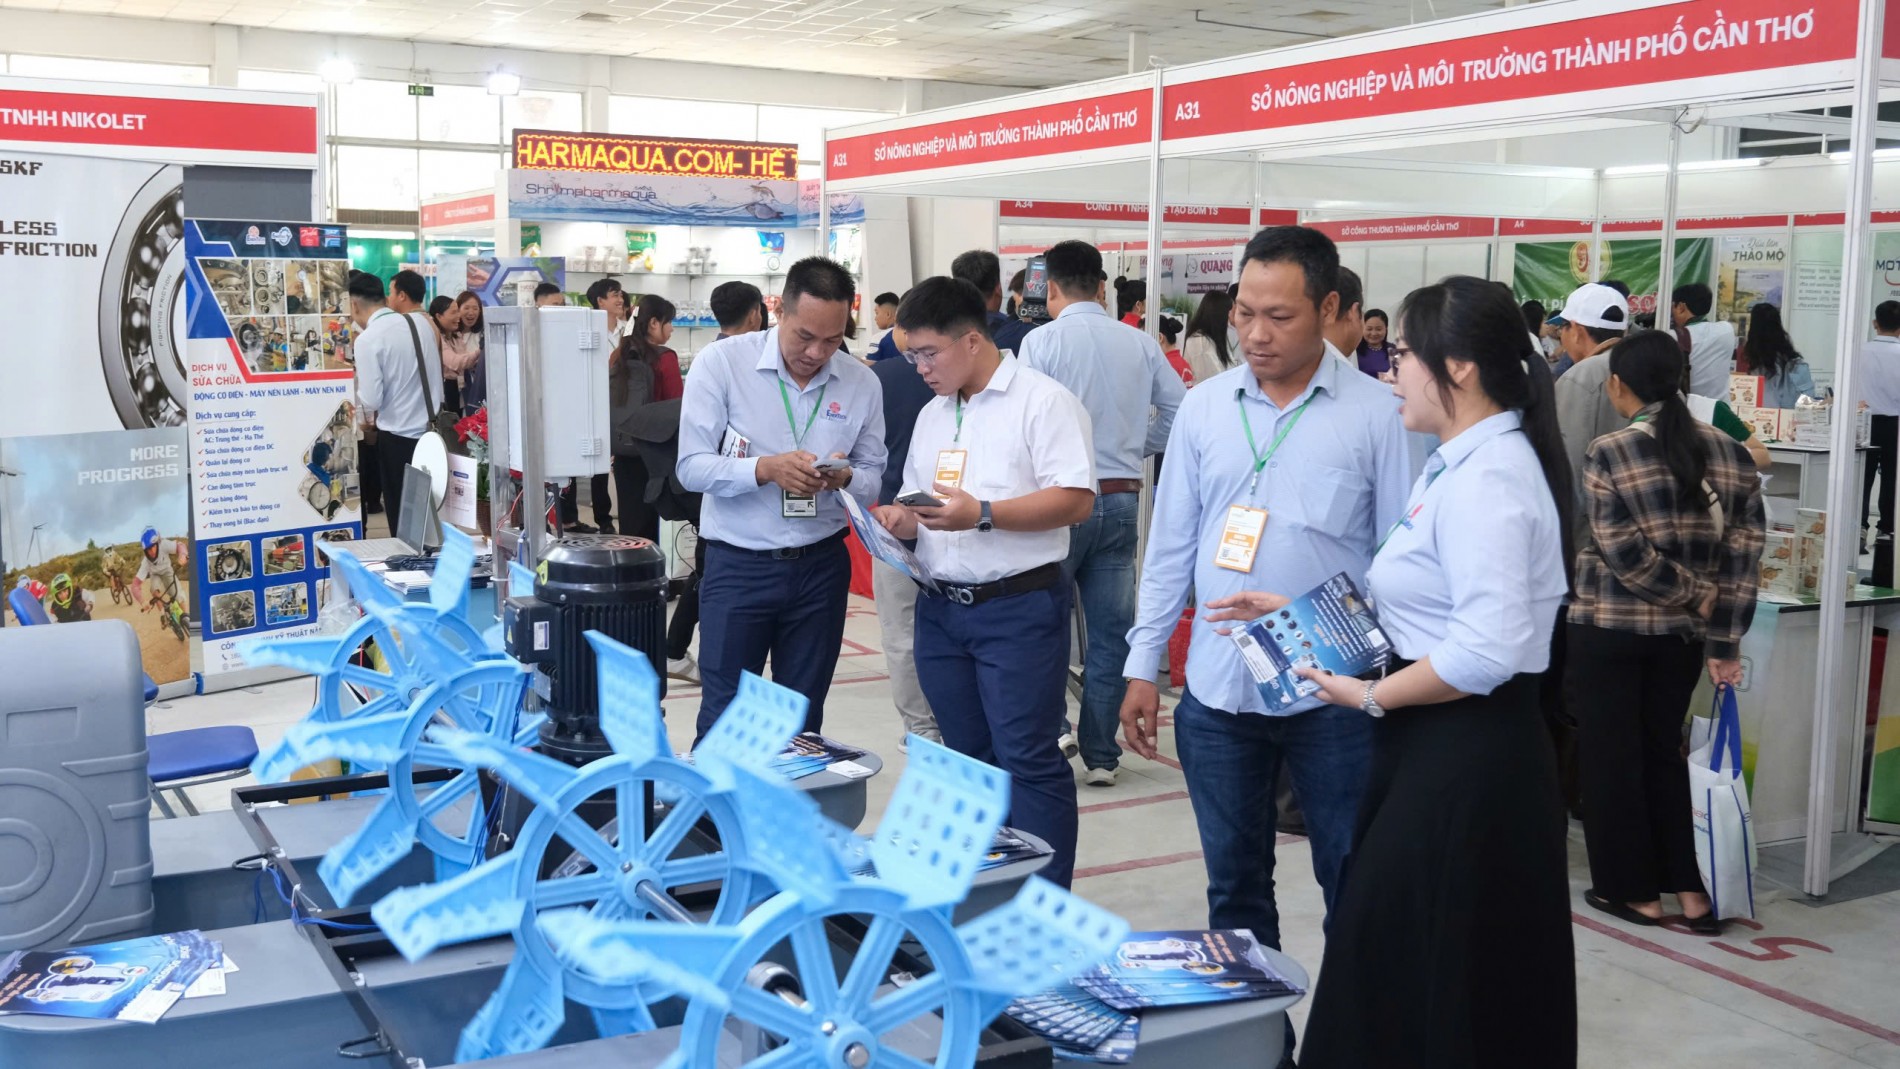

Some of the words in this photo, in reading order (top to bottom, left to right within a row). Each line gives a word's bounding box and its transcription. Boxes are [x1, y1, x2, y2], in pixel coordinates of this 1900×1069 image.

[1175, 101, 1200, 121] A31
[1251, 84, 1272, 112] SỞ
[1275, 81, 1321, 109] NÔNG
[1324, 70, 1387, 101] NGHIỆP
[1390, 67, 1414, 92] VÀ
[1418, 59, 1455, 88] MÔI
[1461, 46, 1547, 83] TRƯỜNG
[1552, 38, 1631, 72] THÀNH
[1635, 15, 1688, 60] PHỐ
[1693, 9, 1749, 52] CẦN
[1755, 8, 1815, 44] THƠ
[0, 108, 58, 126] TNHH
[62, 111, 147, 130] NIKOLET
[833, 153, 847, 167] A31
[874, 142, 886, 161] SỞ
[887, 141, 911, 160] NÔNG
[912, 135, 945, 158] NGHIỆP
[945, 135, 958, 151] VÀ
[959, 130, 977, 149] MÔI
[980, 123, 1020, 147] TRƯỜNG
[1022, 118, 1059, 142] THÀNH
[1060, 108, 1083, 137] PHỐ
[1085, 105, 1110, 132] CẦN
[1112, 108, 1138, 129] THƠ
[0, 160, 43, 175] SKF
[0, 220, 58, 236] LESS
[0, 242, 97, 257] FRICTION
[130, 444, 179, 461] MORE
[77, 463, 179, 486] PROGRESS
